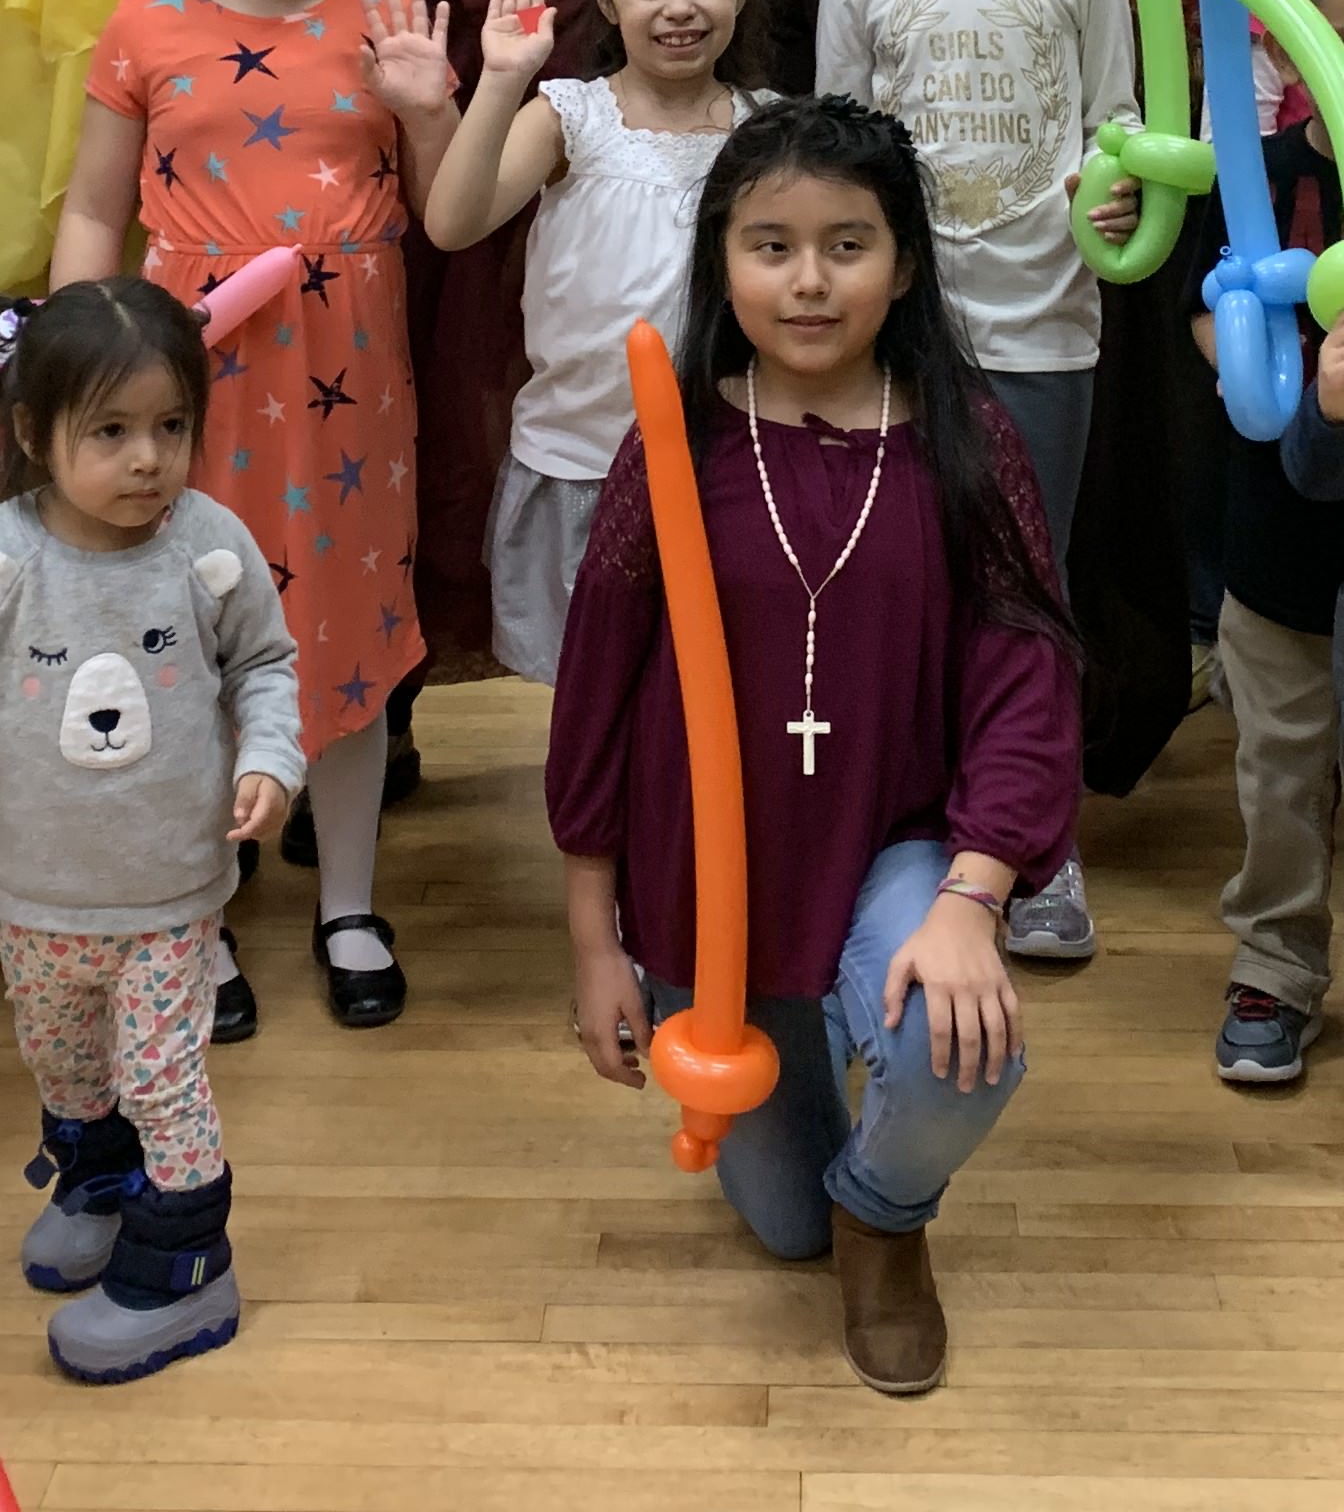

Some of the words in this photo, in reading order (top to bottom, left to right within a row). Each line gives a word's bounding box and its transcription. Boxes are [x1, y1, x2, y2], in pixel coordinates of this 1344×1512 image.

[929, 30, 1004, 61] GIRLS
[923, 73, 972, 103] CAN
[980, 72, 1015, 103] DO
[912, 112, 1031, 144] ANYTHING
